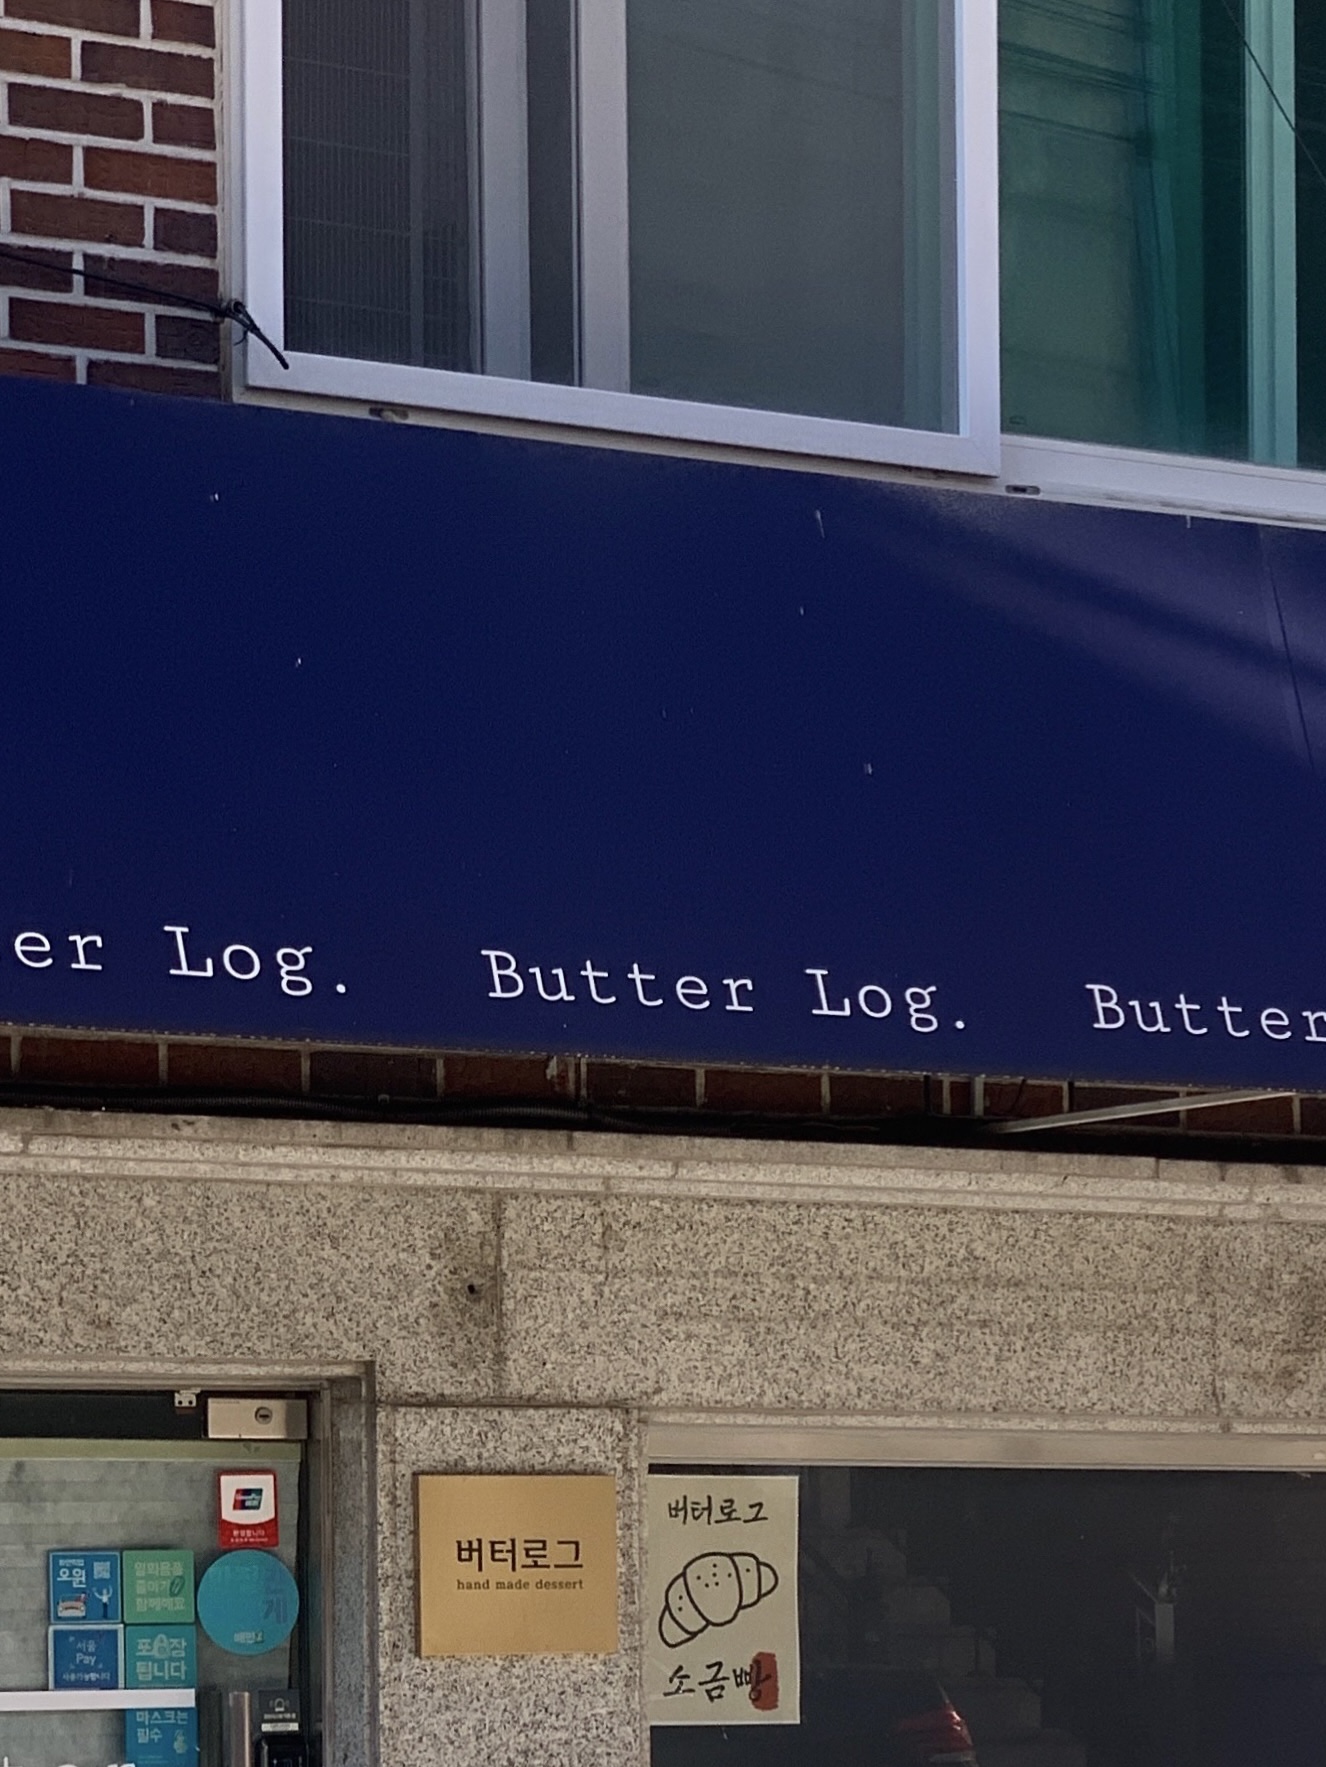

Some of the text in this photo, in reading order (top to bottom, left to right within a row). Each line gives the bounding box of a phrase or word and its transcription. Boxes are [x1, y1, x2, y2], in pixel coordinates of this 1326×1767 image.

[163, 925, 346, 996] Log.
[480, 949, 965, 1033] Butter Log.
[667, 1494, 769, 1526] 버터로그
[455, 1538, 584, 1573] 버터로그
[456, 1578, 584, 1590] hand made dessert
[76, 1653, 96, 1666] Pay
[136, 1660, 187, 1681] 됩니다
[662, 1659, 773, 1704] 소금빵
[135, 1710, 189, 1726] 마스크는
[136, 1727, 163, 1744] 필수
